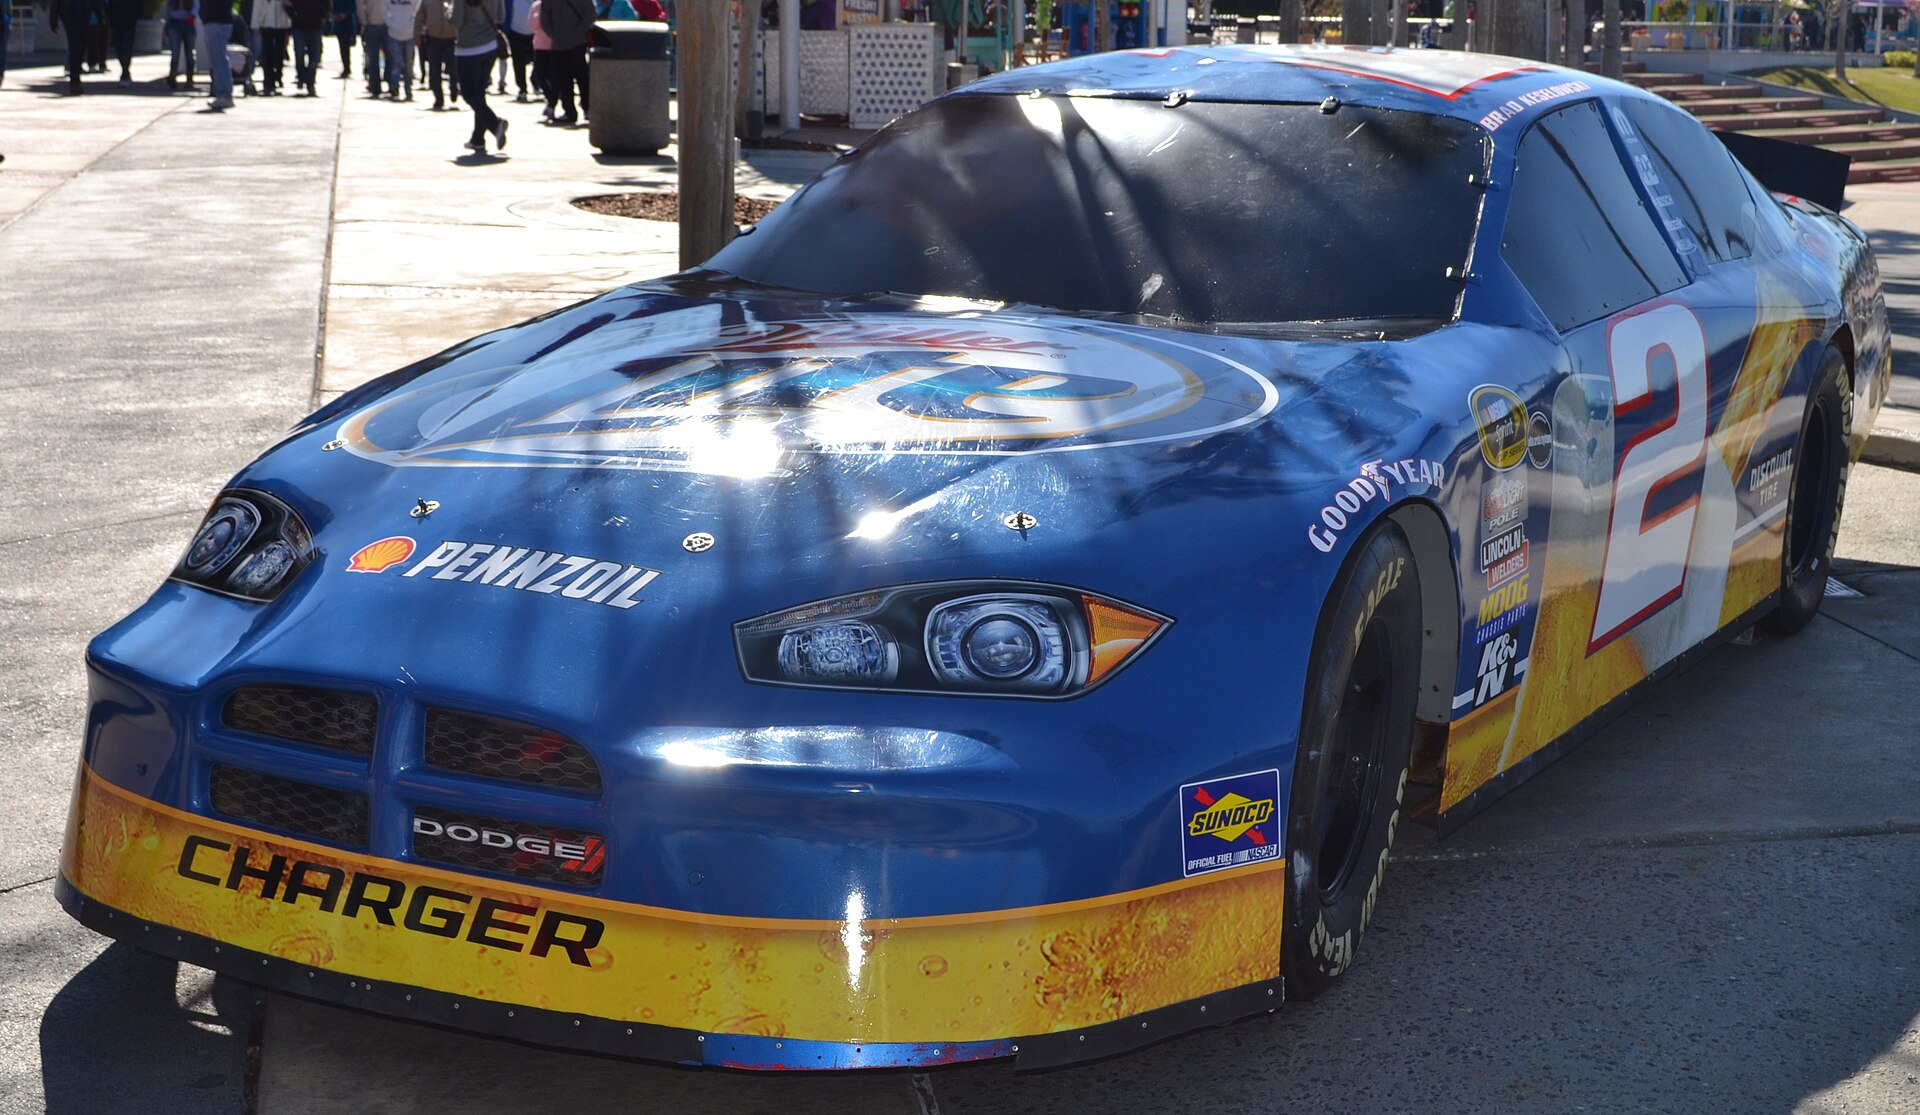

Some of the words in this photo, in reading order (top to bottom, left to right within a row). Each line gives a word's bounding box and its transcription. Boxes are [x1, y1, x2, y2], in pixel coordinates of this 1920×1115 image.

[1480, 100, 1525, 132] BRAD
[1518, 80, 1591, 107] KESELOWSKI
[1495, 417, 1514, 446] Sprint
[1584, 298, 1710, 660] 2
[1750, 448, 1792, 491] DISCOUNT
[1760, 481, 1778, 505] TIRE
[1489, 507, 1520, 531] POLE
[1483, 529, 1521, 567] LINCOLN
[1491, 553, 1525, 583] WELDERS
[402, 540, 661, 609] PENNZOIL
[1354, 557, 1405, 656] EAGLE
[1476, 572, 1530, 628] MOOG
[1477, 632, 1517, 678] K&
[1475, 662, 1508, 707] N
[413, 818, 586, 862] DODGE
[1192, 802, 1271, 834] SUNOCO
[1188, 856, 1216, 870] OFFICIAL
[1217, 852, 1233, 863] FUEL
[1246, 844, 1278, 861] NASCAR
[177, 835, 606, 968] CHARGER
